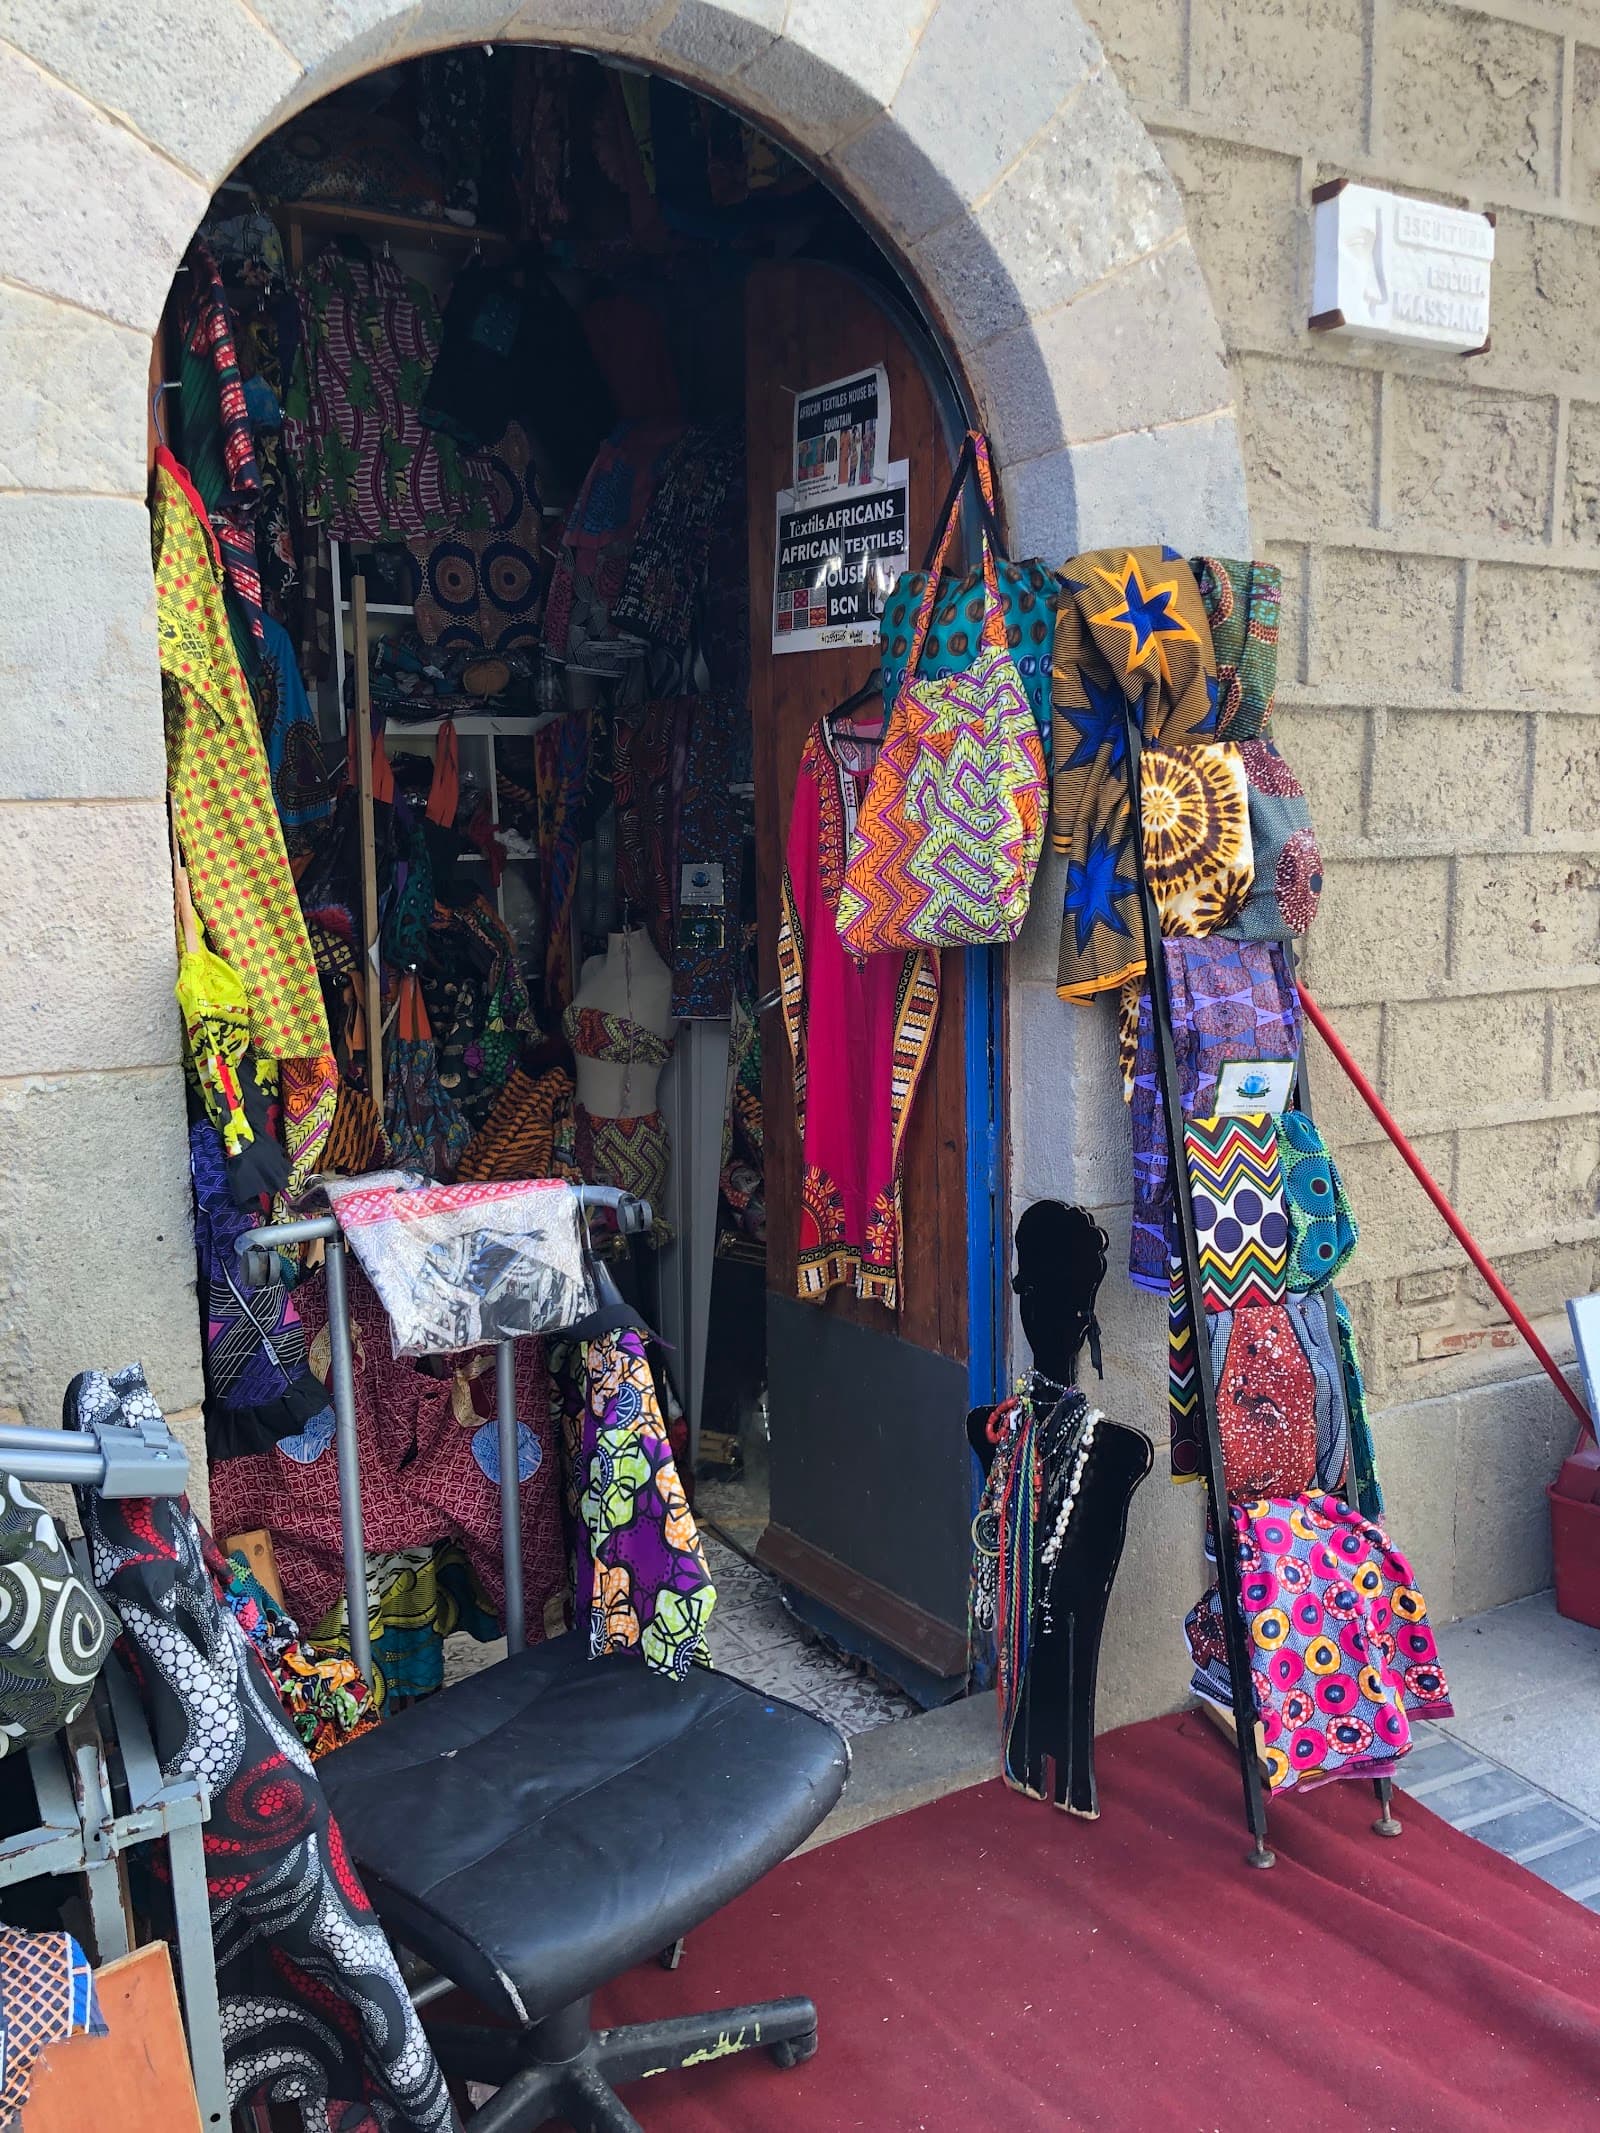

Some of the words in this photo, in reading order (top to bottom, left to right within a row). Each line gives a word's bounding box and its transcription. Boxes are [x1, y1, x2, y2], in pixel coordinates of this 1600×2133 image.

[799, 400, 821, 419] AFRICAN
[822, 393, 848, 413] TEXTILES
[848, 385, 867, 404] HOUSE
[823, 411, 852, 432] FOUNTAIN
[825, 499, 894, 530] AFRICANS
[781, 537, 840, 565] AFRICAN
[845, 529, 904, 554] TEXTILES
[830, 595, 858, 616] BCN
